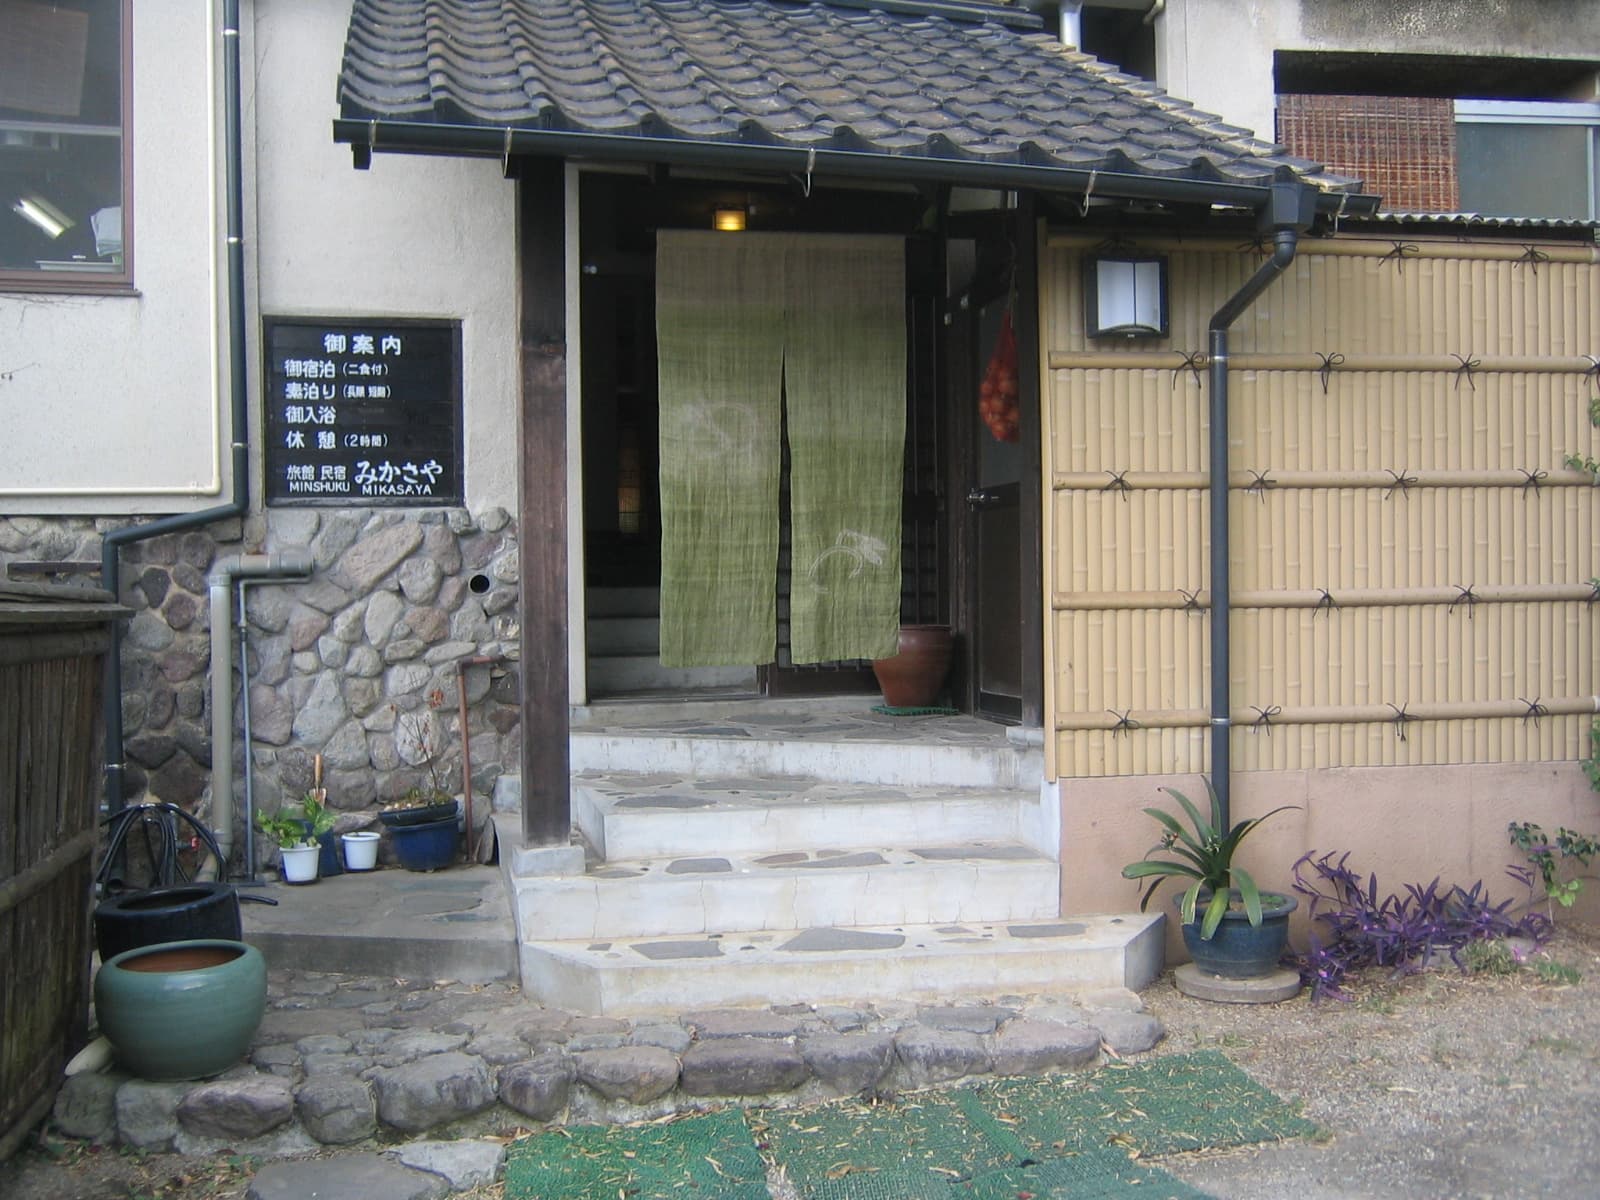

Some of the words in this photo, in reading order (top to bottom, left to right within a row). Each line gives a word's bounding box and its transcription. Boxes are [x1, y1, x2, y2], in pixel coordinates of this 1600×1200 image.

[324, 334, 402, 355] 御案内
[284, 359, 336, 378] 御宿泊
[285, 382, 336, 399] 素泊り
[285, 405, 336, 424] 御入浴
[320, 465, 346, 480] 民宿
[355, 460, 443, 484] みかさや
[289, 481, 350, 493] MINSHUKU
[362, 484, 432, 495] MIKASAYA
